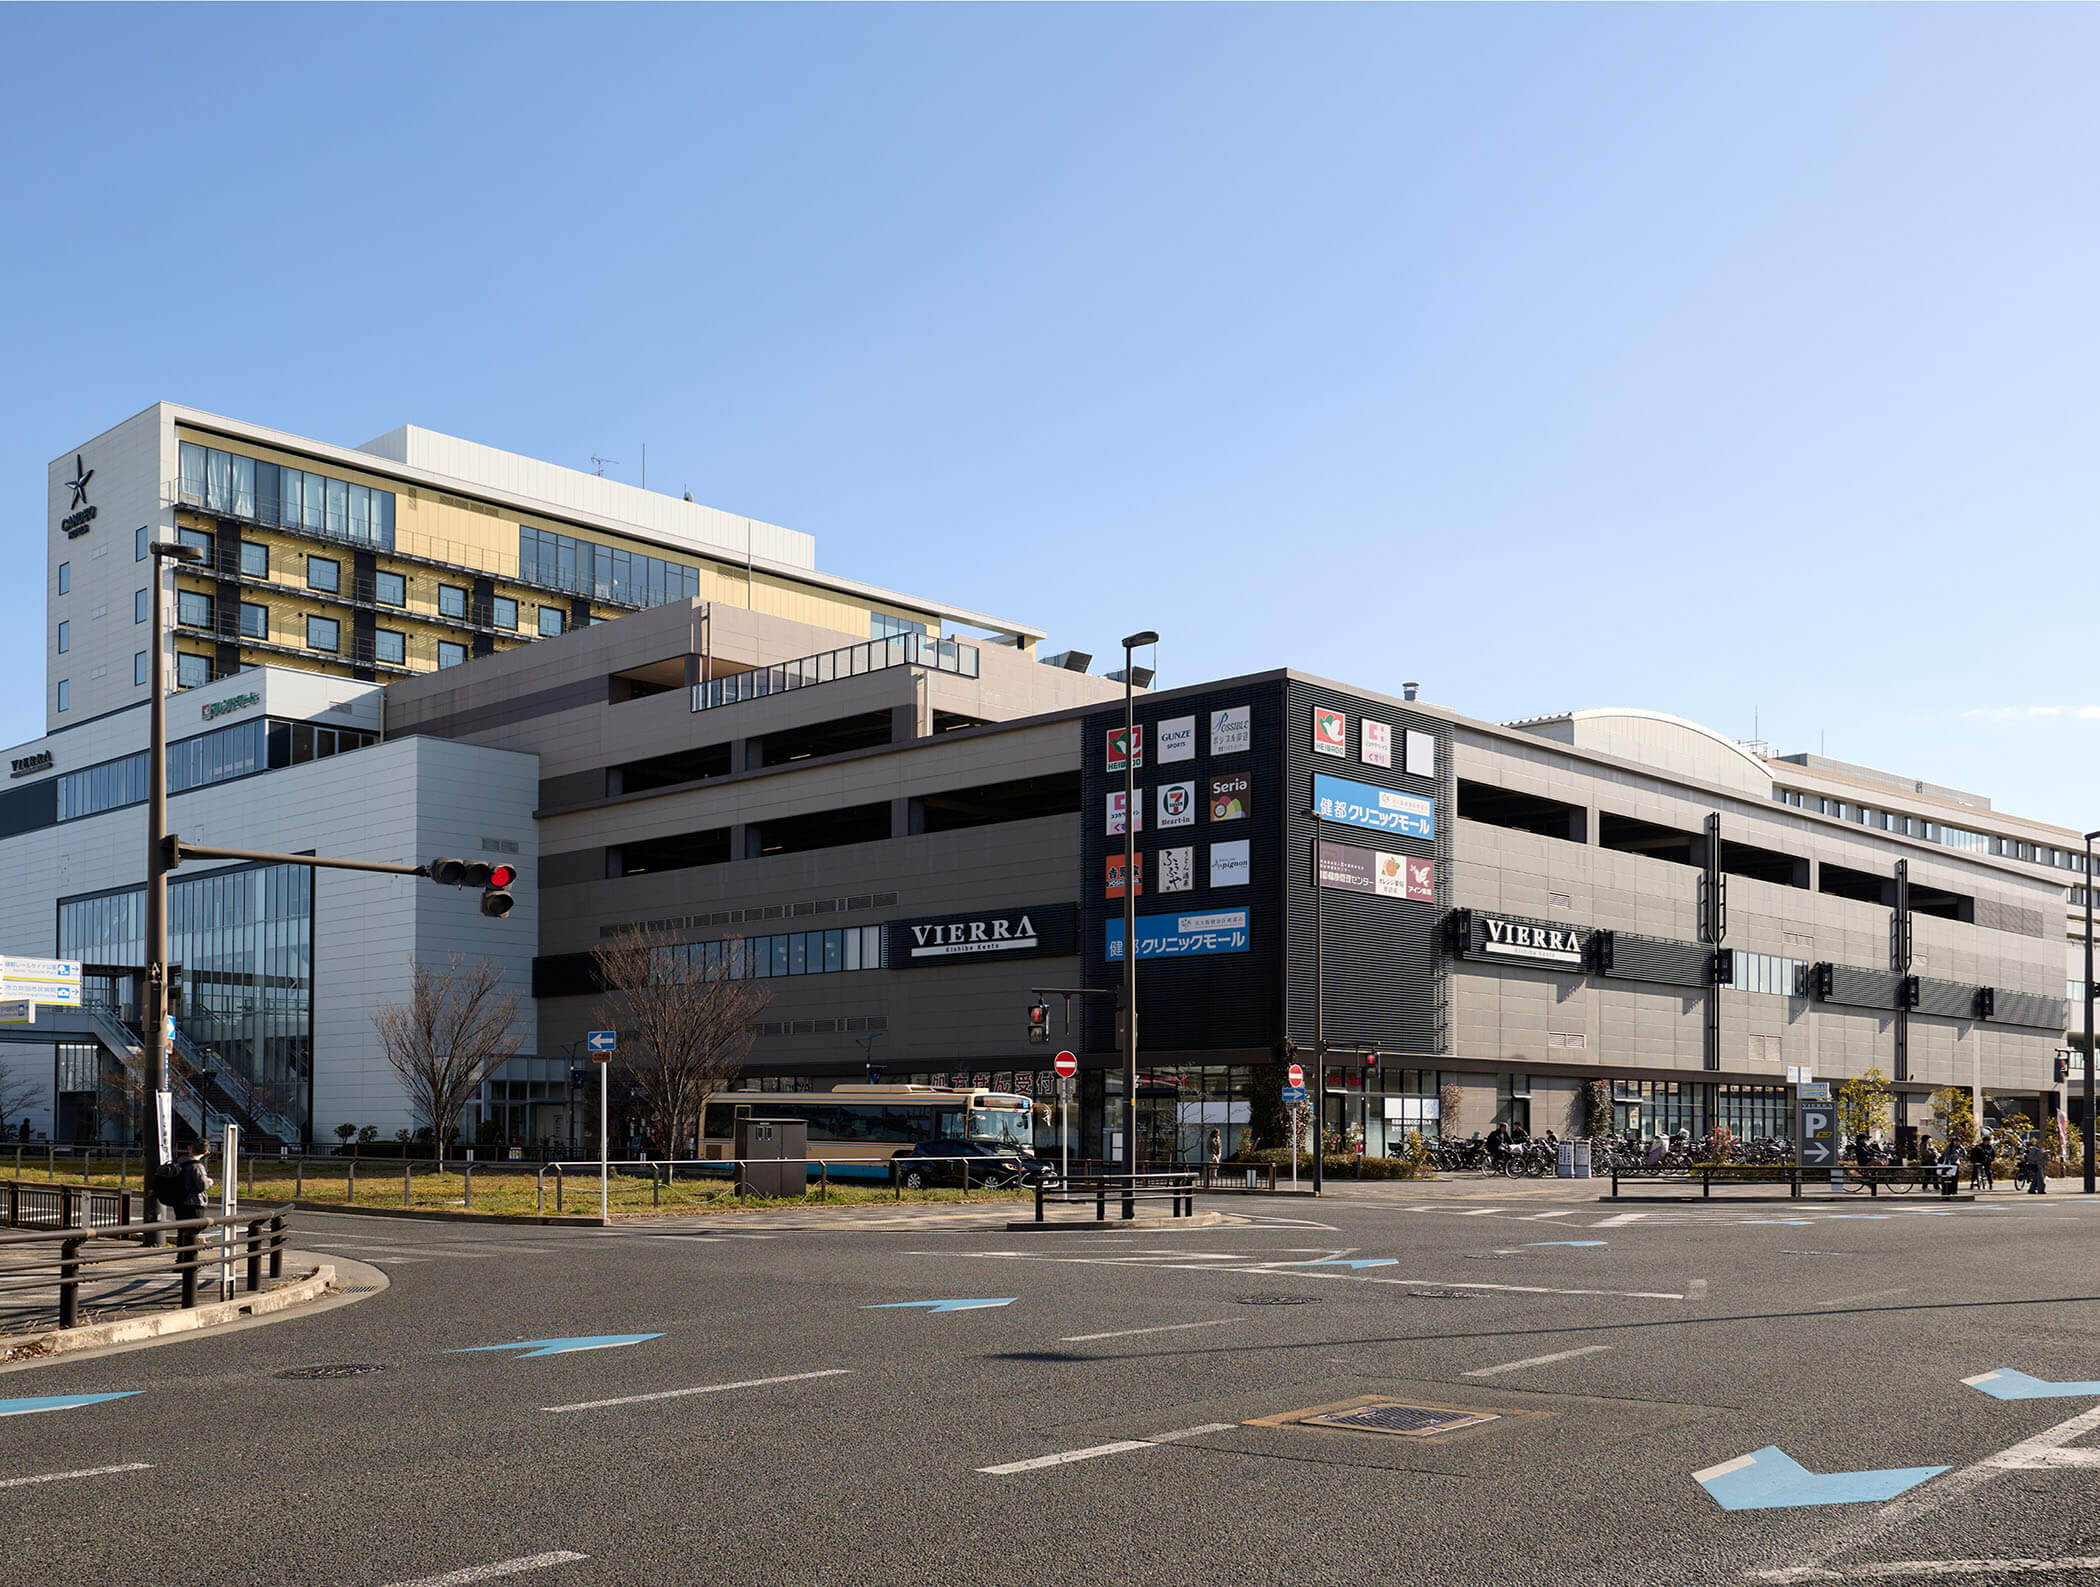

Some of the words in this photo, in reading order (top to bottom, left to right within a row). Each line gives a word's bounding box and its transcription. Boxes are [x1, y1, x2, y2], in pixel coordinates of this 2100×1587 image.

[1161, 729, 1191, 742] GUNZE
[1167, 741, 1186, 749] SPORTS
[1213, 778, 1248, 794] Seria
[1320, 797, 1430, 835] 健都クリニックモール
[911, 915, 1037, 946] VIERRA
[1486, 919, 1581, 953] VIERRA
[932, 1073, 1054, 1095] 処方せん受付
[1805, 1112, 1828, 1139] P
